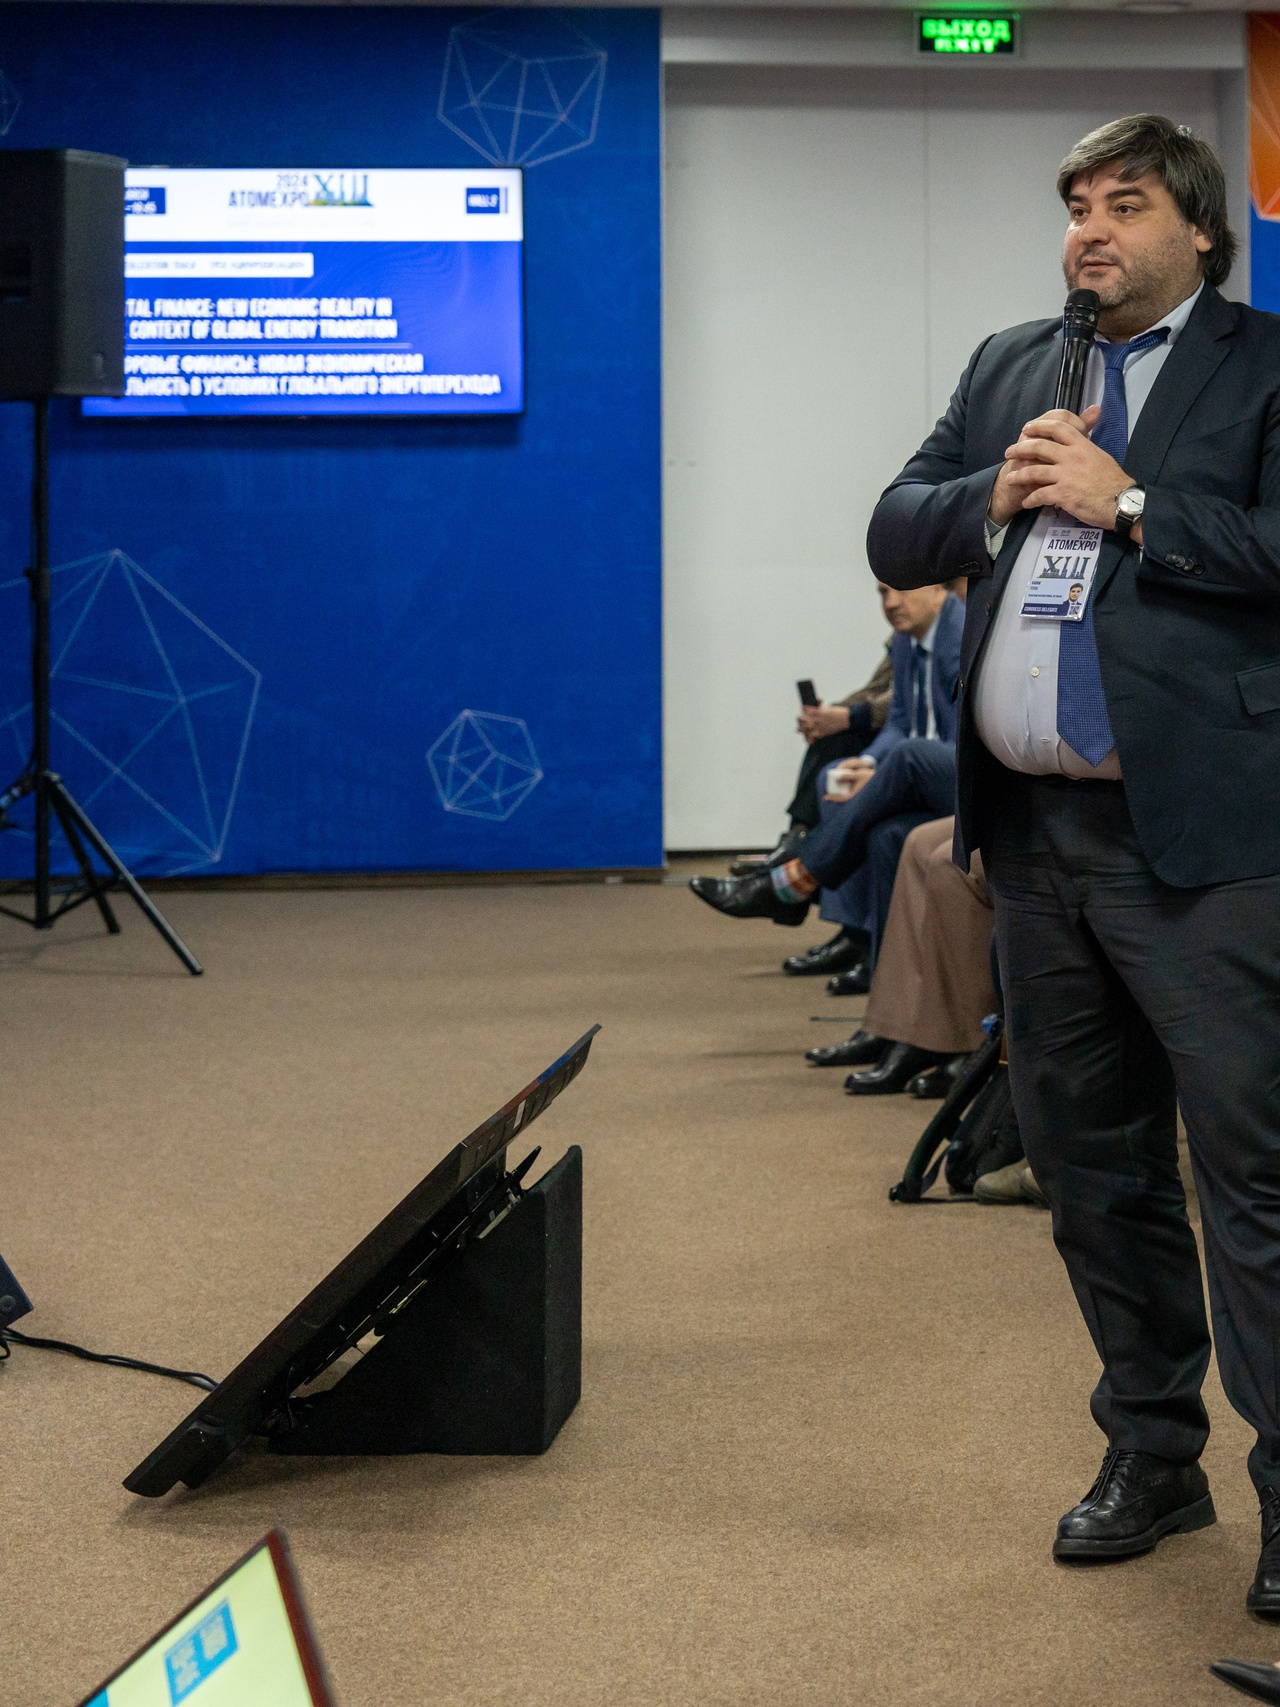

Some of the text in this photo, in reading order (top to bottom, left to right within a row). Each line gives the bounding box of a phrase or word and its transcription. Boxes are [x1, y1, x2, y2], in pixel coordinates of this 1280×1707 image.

[922, 19, 1011, 42] ВЫХОД
[934, 37, 998, 53] EXIT
[228, 189, 309, 208] ATOMEXPO
[217, 298, 249, 317] NEW
[250, 298, 319, 317] ECONOMIC
[320, 297, 376, 317] REALITY
[130, 319, 398, 339] CONTEXT OF GLOBAL ENERGY TRANSITION
[1078, 531, 1100, 540] 2024
[1047, 539, 1097, 552] ATOMEXPO
